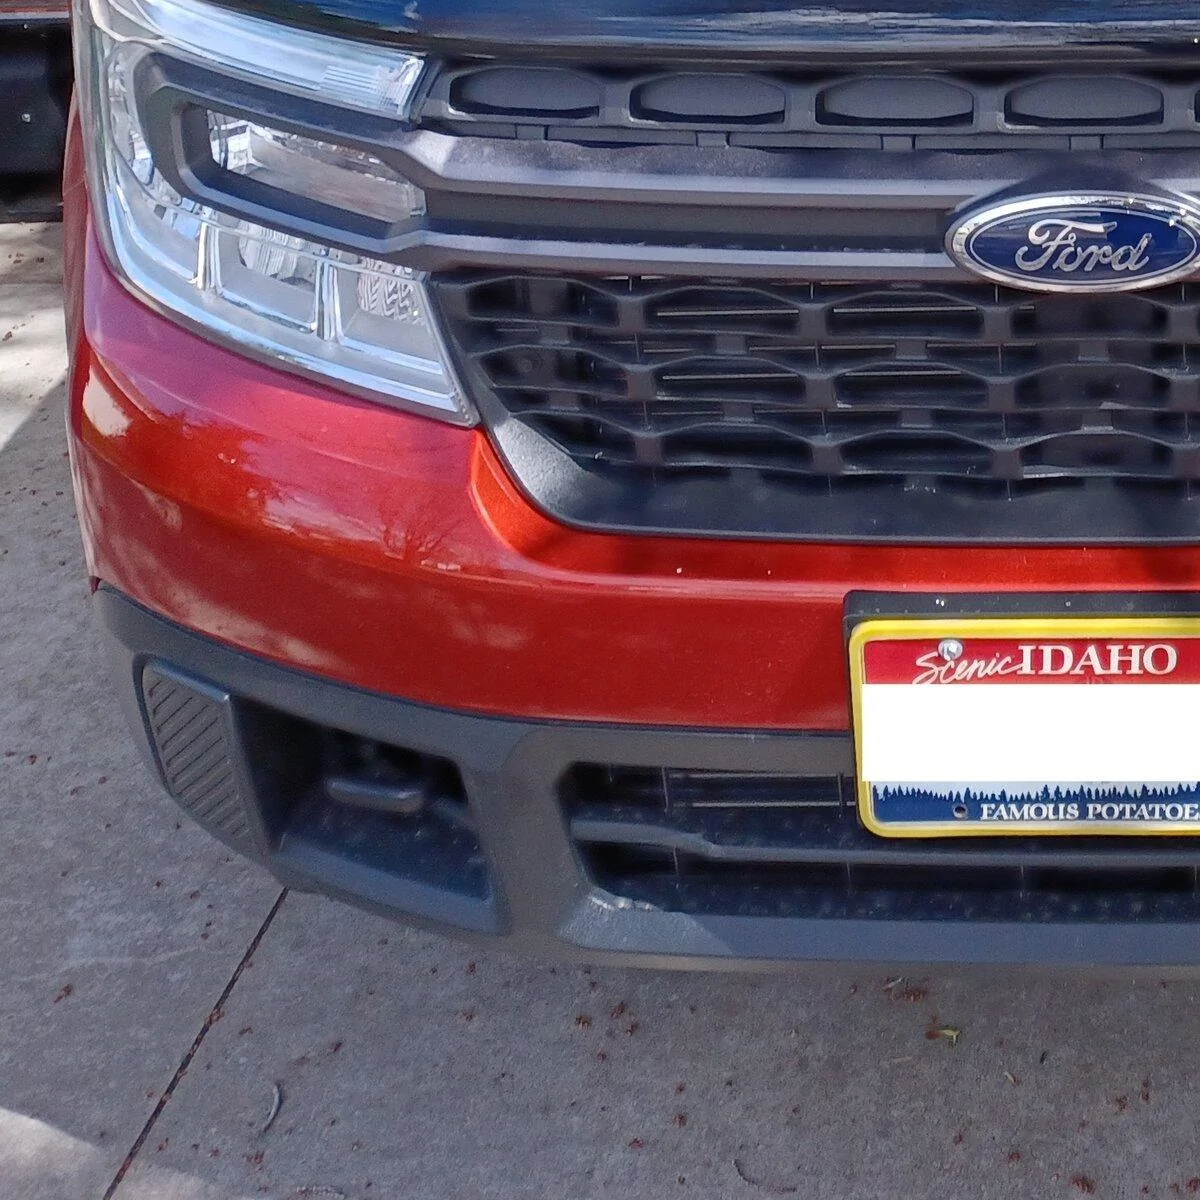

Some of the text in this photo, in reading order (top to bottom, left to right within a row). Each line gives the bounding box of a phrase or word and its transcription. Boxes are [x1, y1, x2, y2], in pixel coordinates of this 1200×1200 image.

[1015, 218, 1152, 273] Ford
[912, 644, 1178, 685] Scenic IDAHO
[980, 803, 1079, 822] FAMOUS
